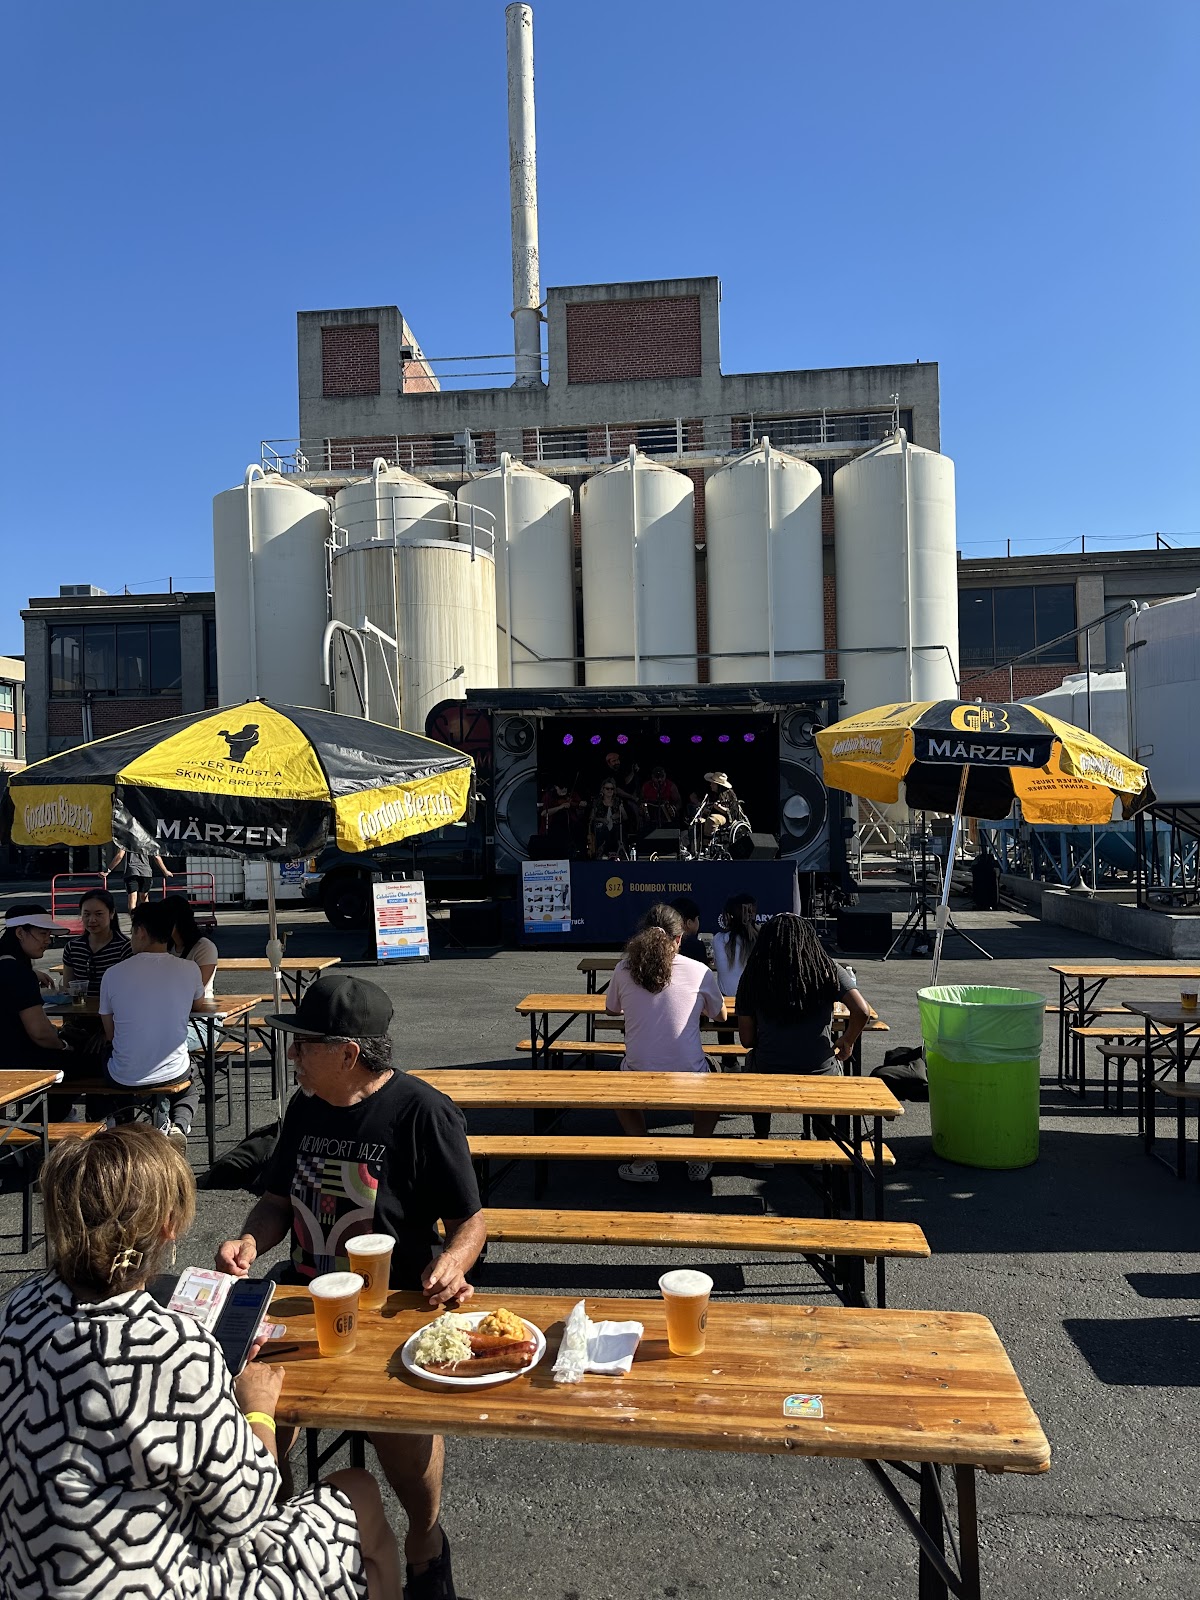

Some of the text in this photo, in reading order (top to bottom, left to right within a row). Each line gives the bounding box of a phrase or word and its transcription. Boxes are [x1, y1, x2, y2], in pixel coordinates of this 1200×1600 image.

[951, 705, 1010, 733] GB
[928, 739, 1035, 763] MÄRZEN
[175, 768, 224, 783] SKINNY
[229, 764, 268, 777] TRUST
[24, 794, 94, 835] Gordon Biersch
[358, 789, 454, 841] Gordon Biersch
[155, 816, 288, 847] MÄRZEN
[629, 882, 693, 892] BOOMBOX TRUCK
[755, 913, 774, 922] ARY
[299, 1134, 387, 1162] NEWPORT JAZZ
[336, 1315, 353, 1333] GB
